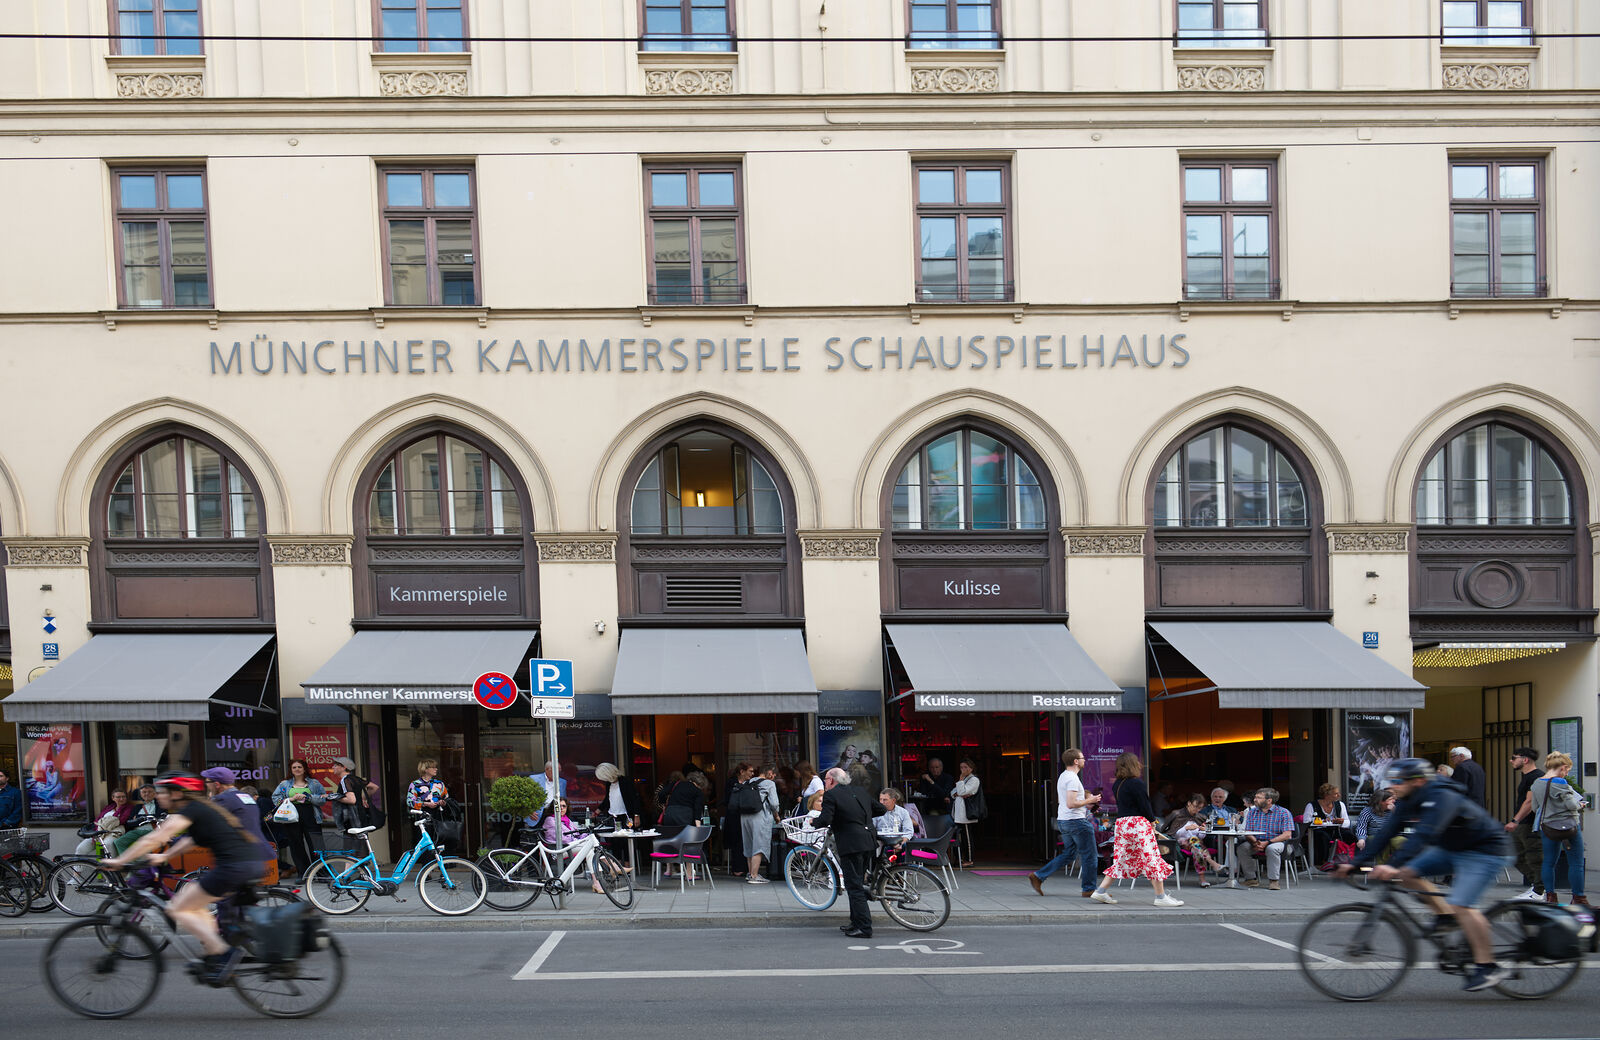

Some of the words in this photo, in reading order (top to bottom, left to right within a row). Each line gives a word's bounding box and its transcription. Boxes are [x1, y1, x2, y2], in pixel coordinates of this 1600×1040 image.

[210, 334, 454, 374] MÜNCHNER
[478, 337, 800, 373] KAMMERSPIELE
[824, 334, 1191, 370] SCHAUSPIELHAUS
[944, 580, 1001, 596] Kulisse
[390, 586, 508, 605] Kammerspiele
[1366, 632, 1377, 641] 26
[44, 644, 57, 653] 28
[538, 664, 560, 692] P
[309, 687, 389, 700] Münchner
[393, 688, 475, 702] Kammersp
[920, 695, 976, 706] Kulisse
[1032, 695, 1117, 706] Restaurant
[216, 735, 266, 752] Jiyan
[305, 747, 341, 755] HABIBI
[306, 755, 334, 764] KIOS
[234, 766, 270, 780] zadî
